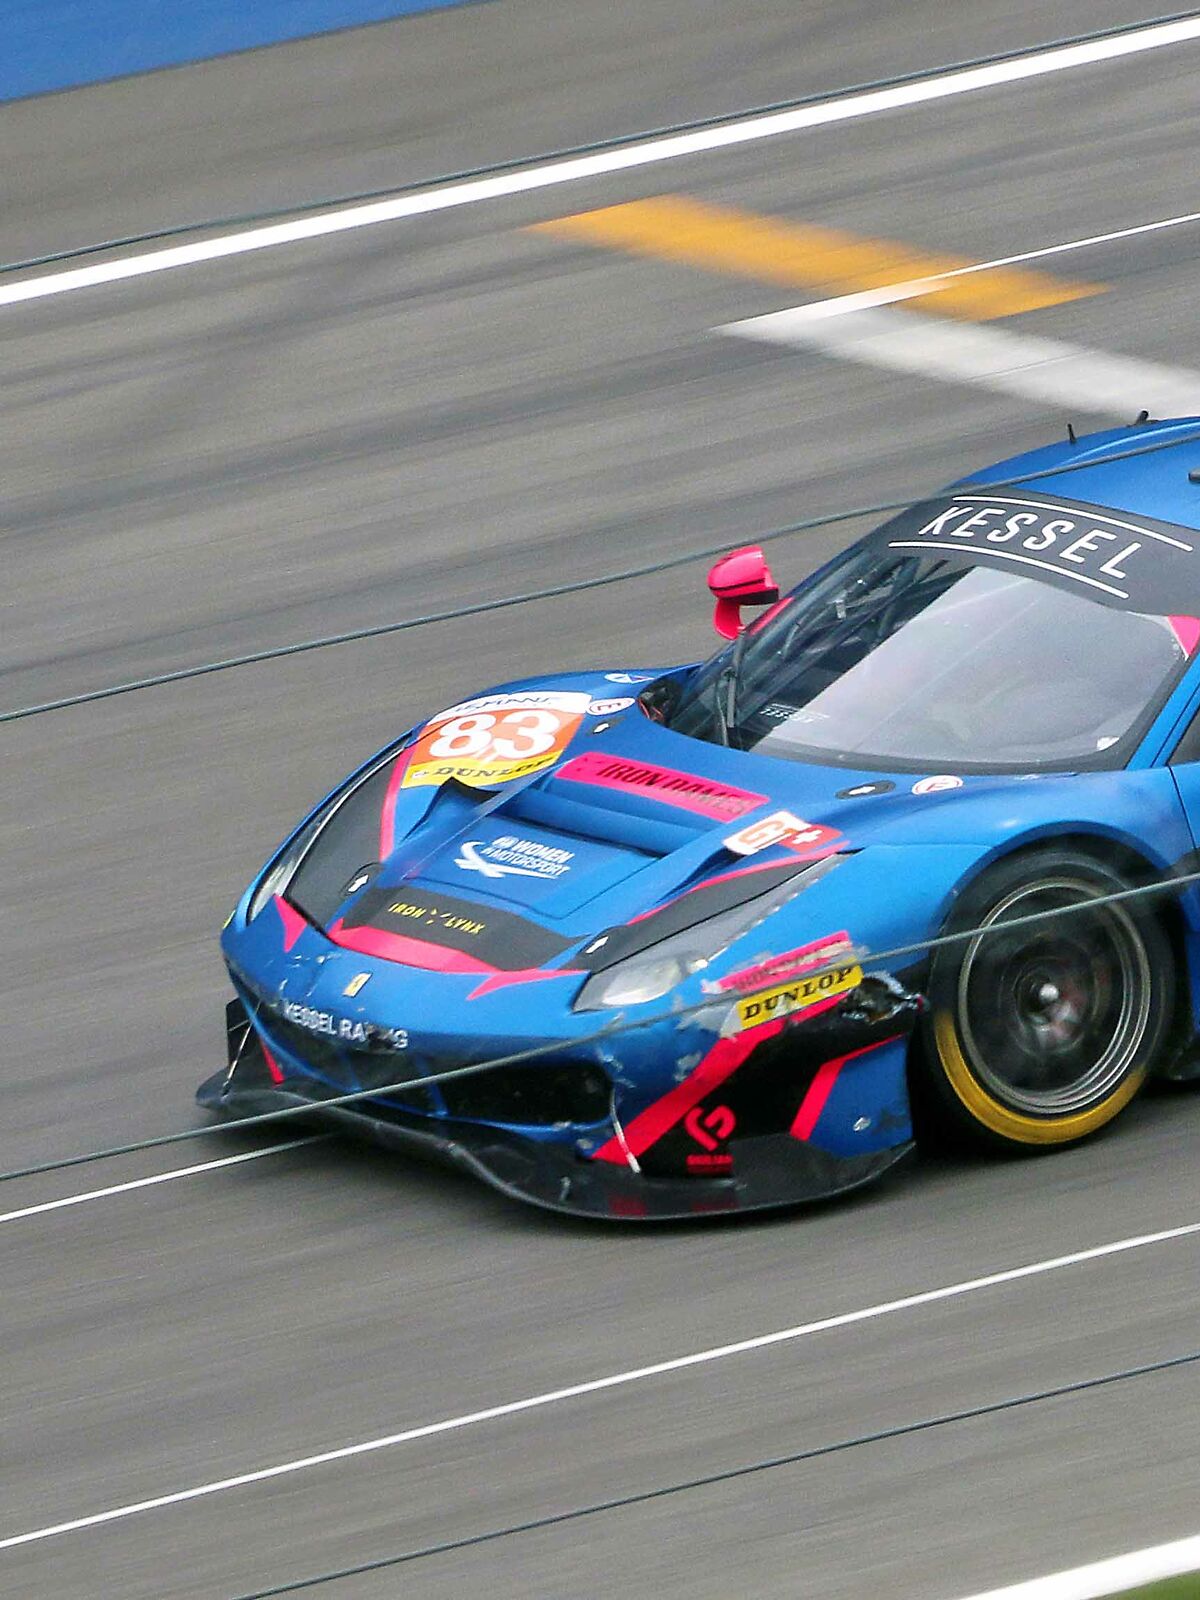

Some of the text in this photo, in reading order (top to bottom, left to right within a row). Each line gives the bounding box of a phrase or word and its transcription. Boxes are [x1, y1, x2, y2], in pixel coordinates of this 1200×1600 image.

[918, 506, 1142, 579] KESSEL
[429, 709, 561, 760] 83
[434, 756, 556, 778] DUNLOP
[597, 762, 665, 787] IRON
[512, 840, 576, 864] WOMEN
[388, 902, 486, 936] IRON LYNX
[743, 967, 853, 1021] DUNLOP
